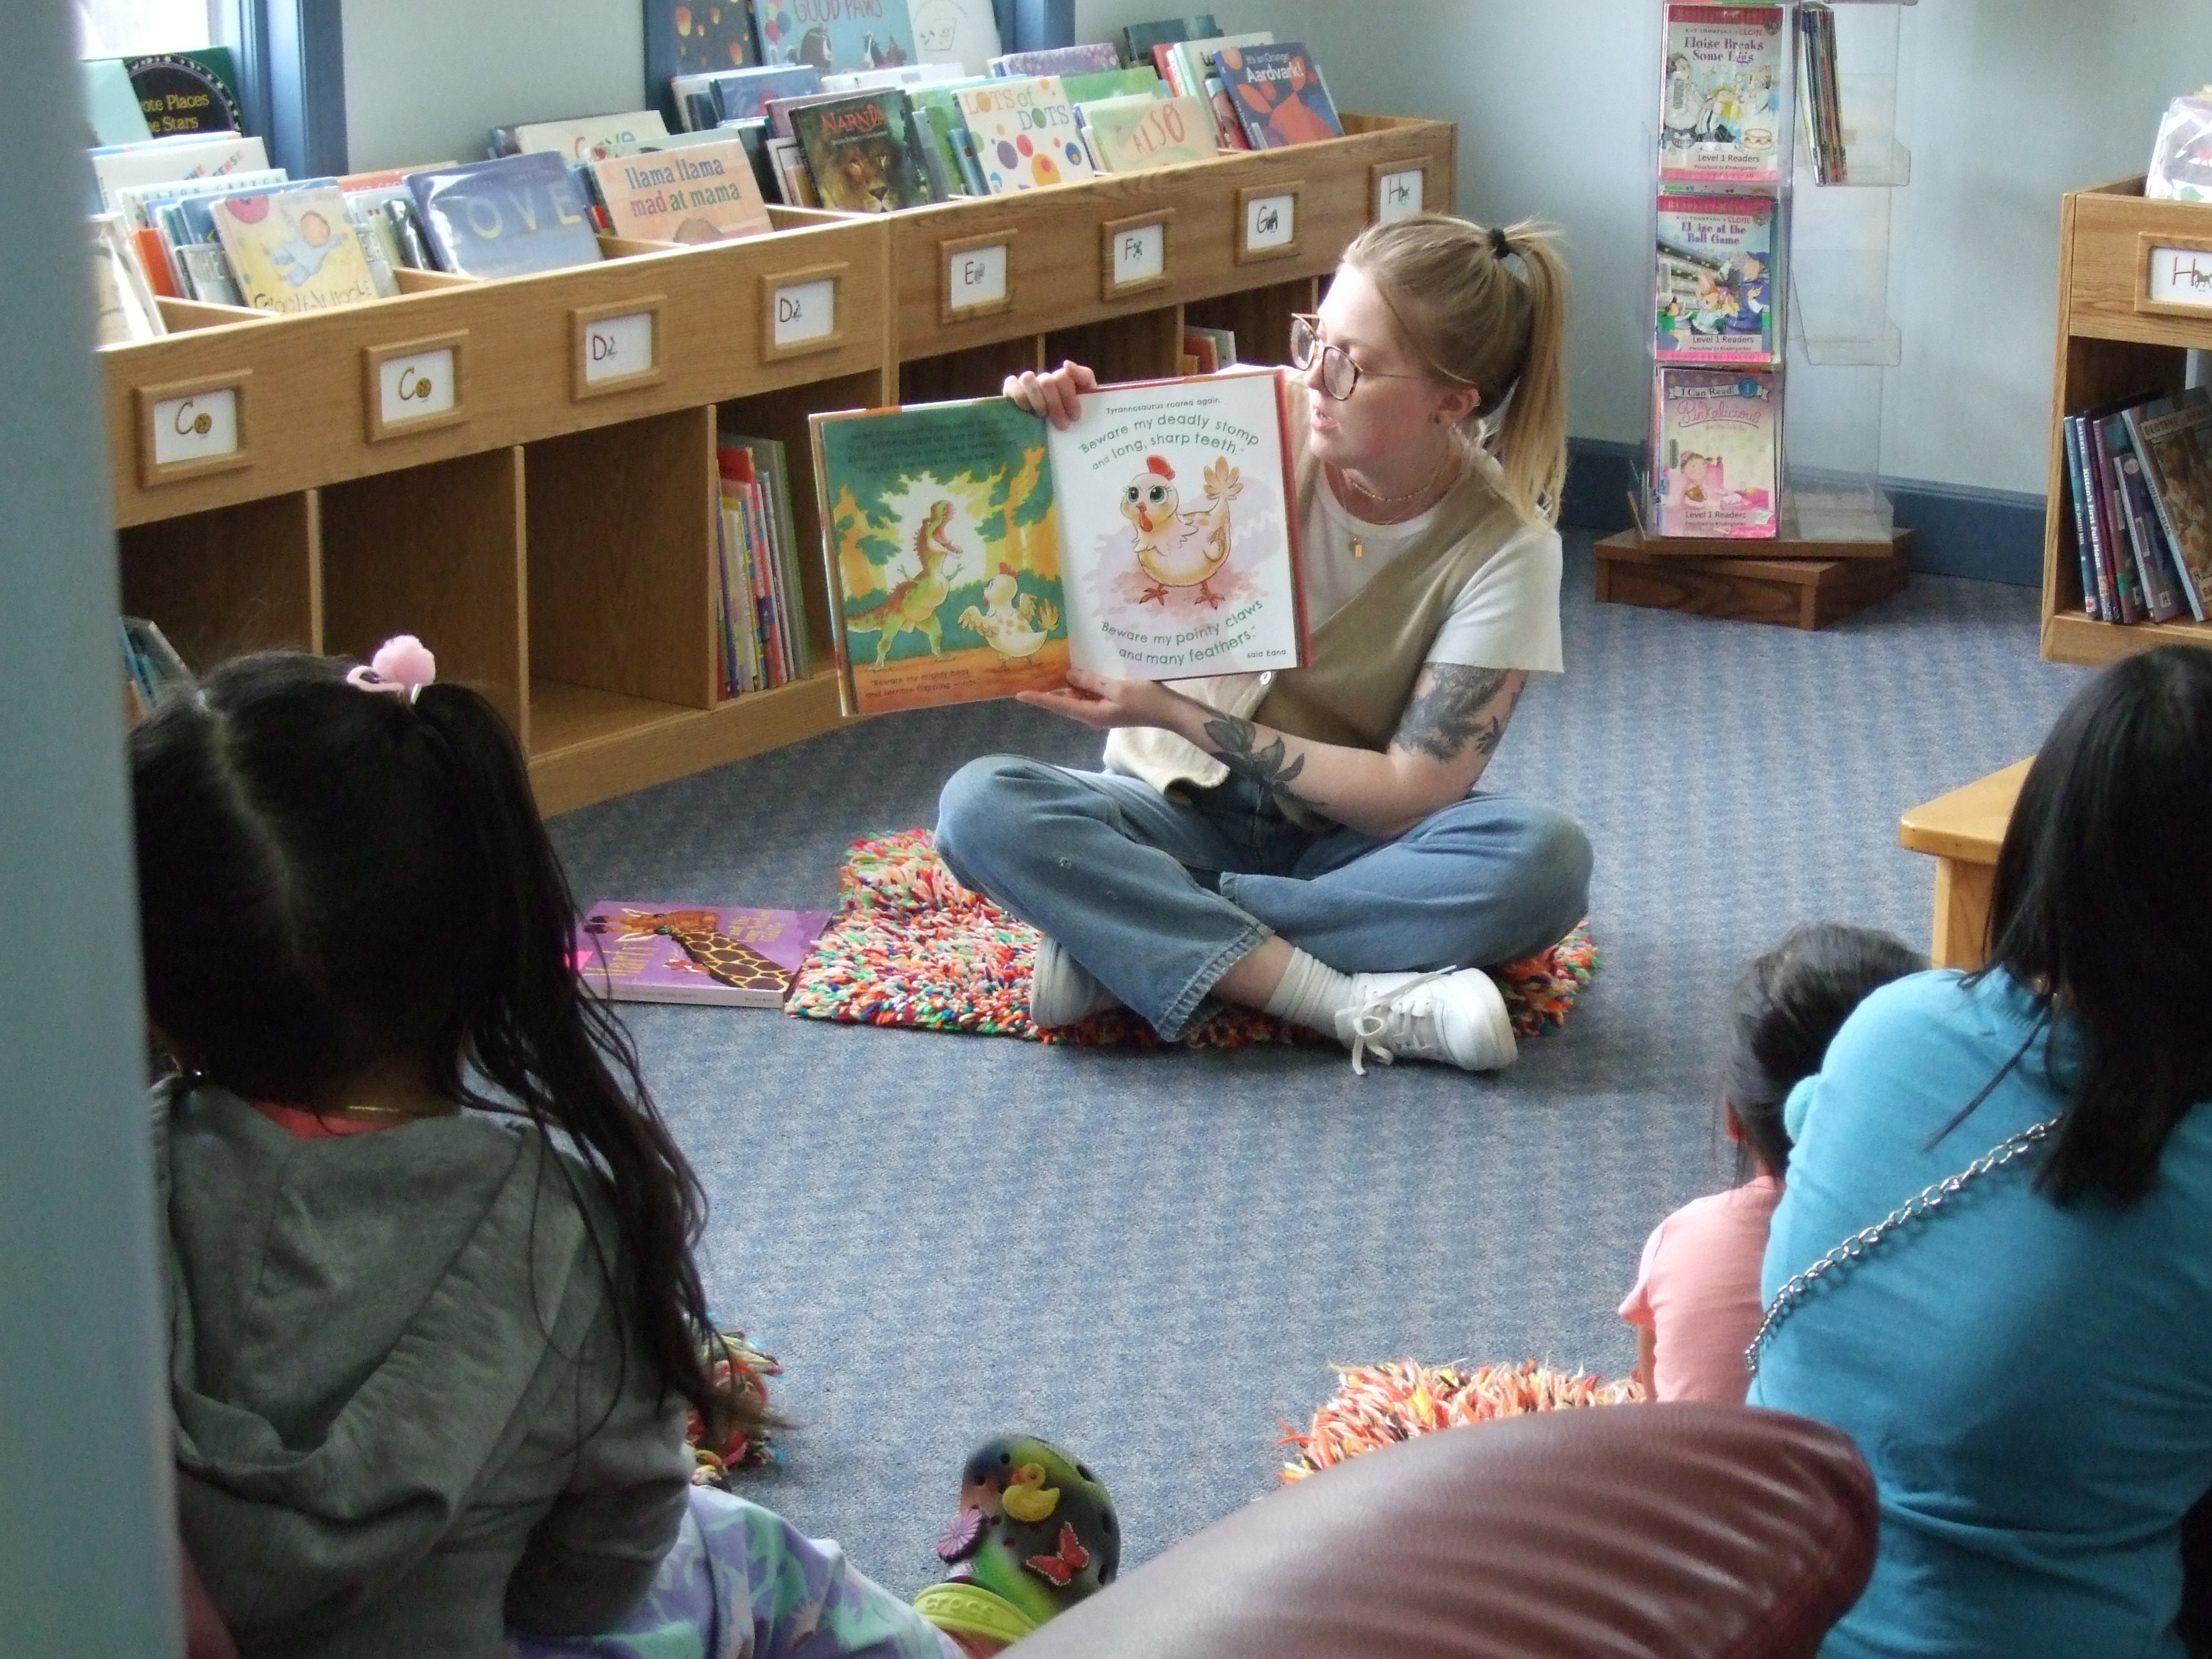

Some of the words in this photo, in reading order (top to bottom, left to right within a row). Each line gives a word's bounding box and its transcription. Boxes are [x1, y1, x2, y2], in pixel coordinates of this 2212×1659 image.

[1685, 36, 1720, 49] Eloise
[1725, 38, 1764, 50] Breaks
[1693, 50, 1723, 62] Some
[1728, 51, 1754, 64] Eggs
[1246, 62, 1305, 83] Aardvark!
[166, 93, 210, 110] Places
[964, 89, 1015, 115] LOTS
[1017, 85, 1035, 107] of
[162, 116, 199, 131] Stars
[1017, 105, 1070, 130] DOTS
[1132, 101, 1185, 154] ALSO
[1727, 154, 1760, 162] Readers
[625, 166, 676, 190] llama
[675, 158, 725, 182] llama
[630, 190, 667, 217] mad
[669, 189, 688, 212] at
[689, 182, 742, 207] mama
[1681, 221, 1712, 233] Elise
[1716, 223, 1726, 232] at
[1729, 223, 1746, 234] the
[1688, 233, 1707, 243] Ball
[1711, 234, 1740, 245] Game
[2172, 256, 2196, 287] H
[1688, 389, 1707, 397] Can
[1709, 387, 1735, 395] Read!
[1106, 403, 1164, 415] Tyrannosaurus
[1166, 399, 1194, 409] roared
[1678, 399, 1762, 424] Pinkalicious
[1134, 418, 1153, 430] my
[1157, 413, 1209, 429] deadly
[1215, 421, 1259, 446] stomp
[2078, 425, 2086, 454] HENKES
[1093, 456, 1110, 470] and
[1111, 440, 1148, 459] long,
[1150, 434, 1190, 446] sharp
[2082, 468, 2093, 504] Kitten's
[1715, 511, 1747, 519] Readers
[2087, 505, 2097, 525] First
[2090, 526, 2099, 544] Full
[2093, 544, 2101, 568] Moon
[1154, 635, 1172, 646] my
[1176, 623, 1219, 646] pointy
[1225, 600, 1263, 627] claws
[1119, 648, 1143, 662] and
[1146, 654, 1185, 666] many
[865, 690, 881, 699] and
[883, 686, 913, 697] terrible
[925, 1597, 994, 1621] crocs
